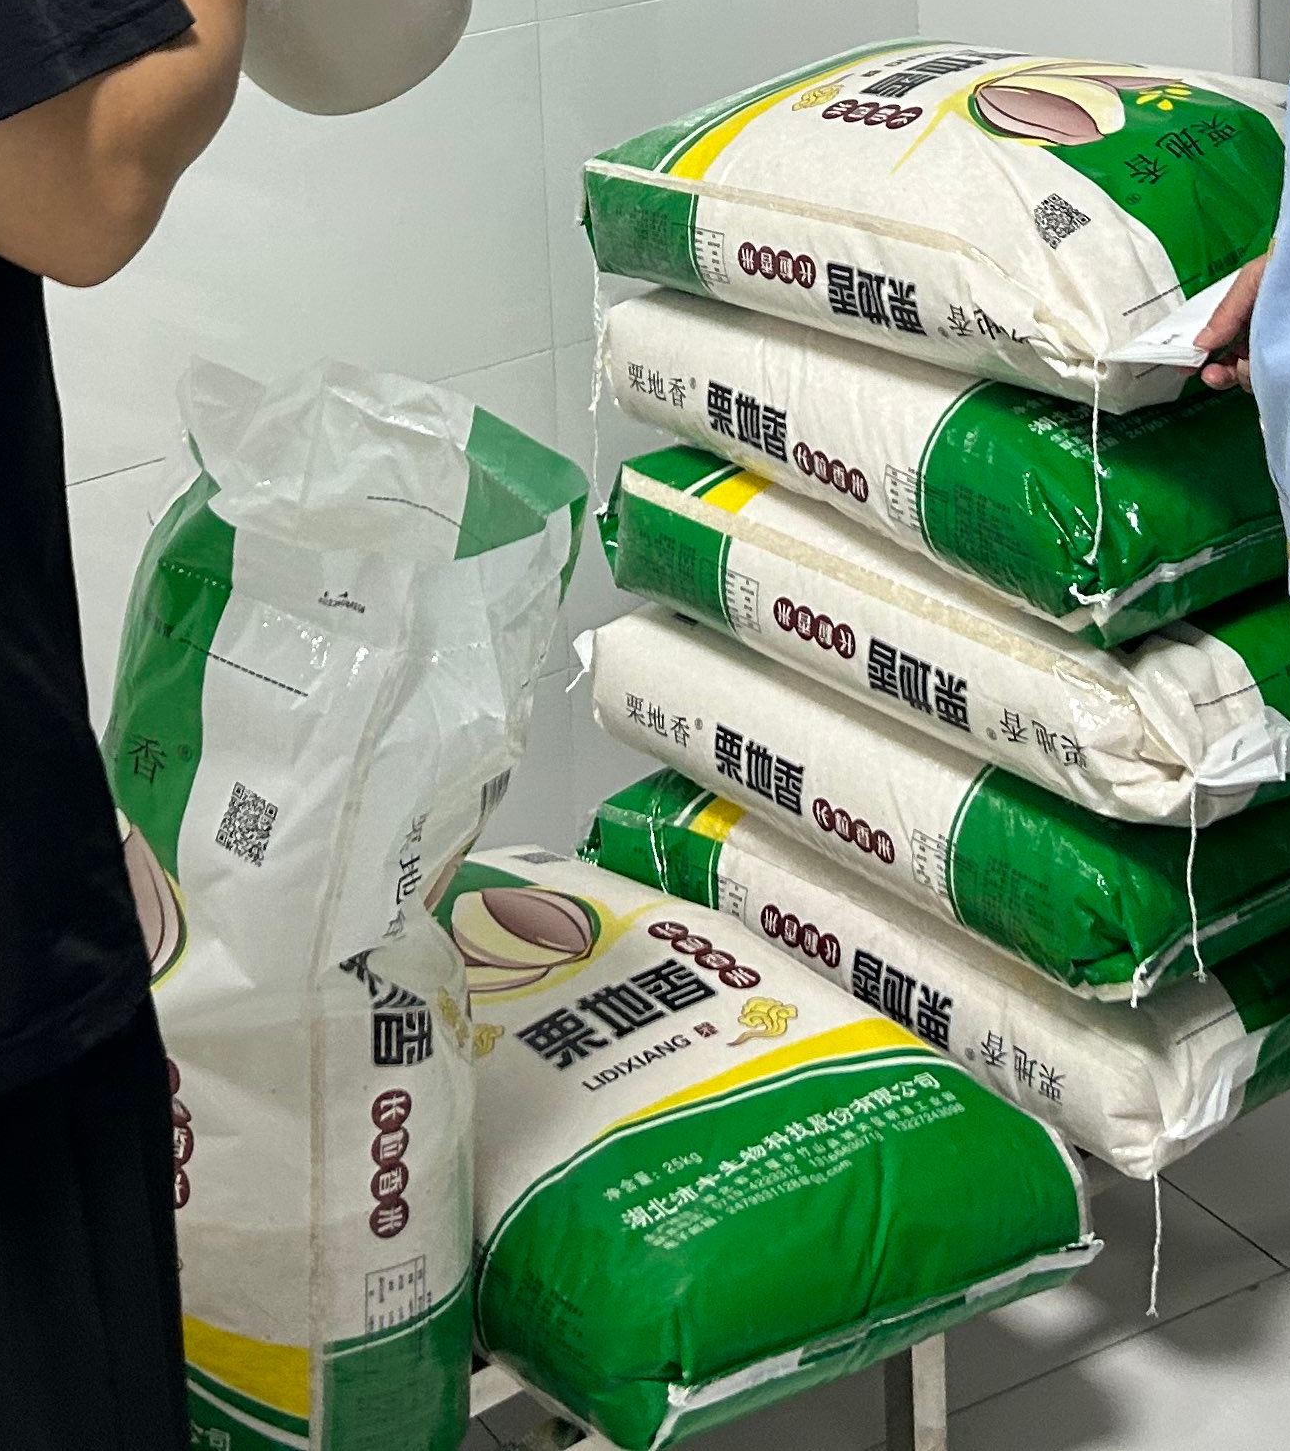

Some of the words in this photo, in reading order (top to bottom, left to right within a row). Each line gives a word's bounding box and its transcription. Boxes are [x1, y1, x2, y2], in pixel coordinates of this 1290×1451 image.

[517, 957, 718, 1072] 栗地香
[582, 1032, 691, 1094] LIDIXIANG
